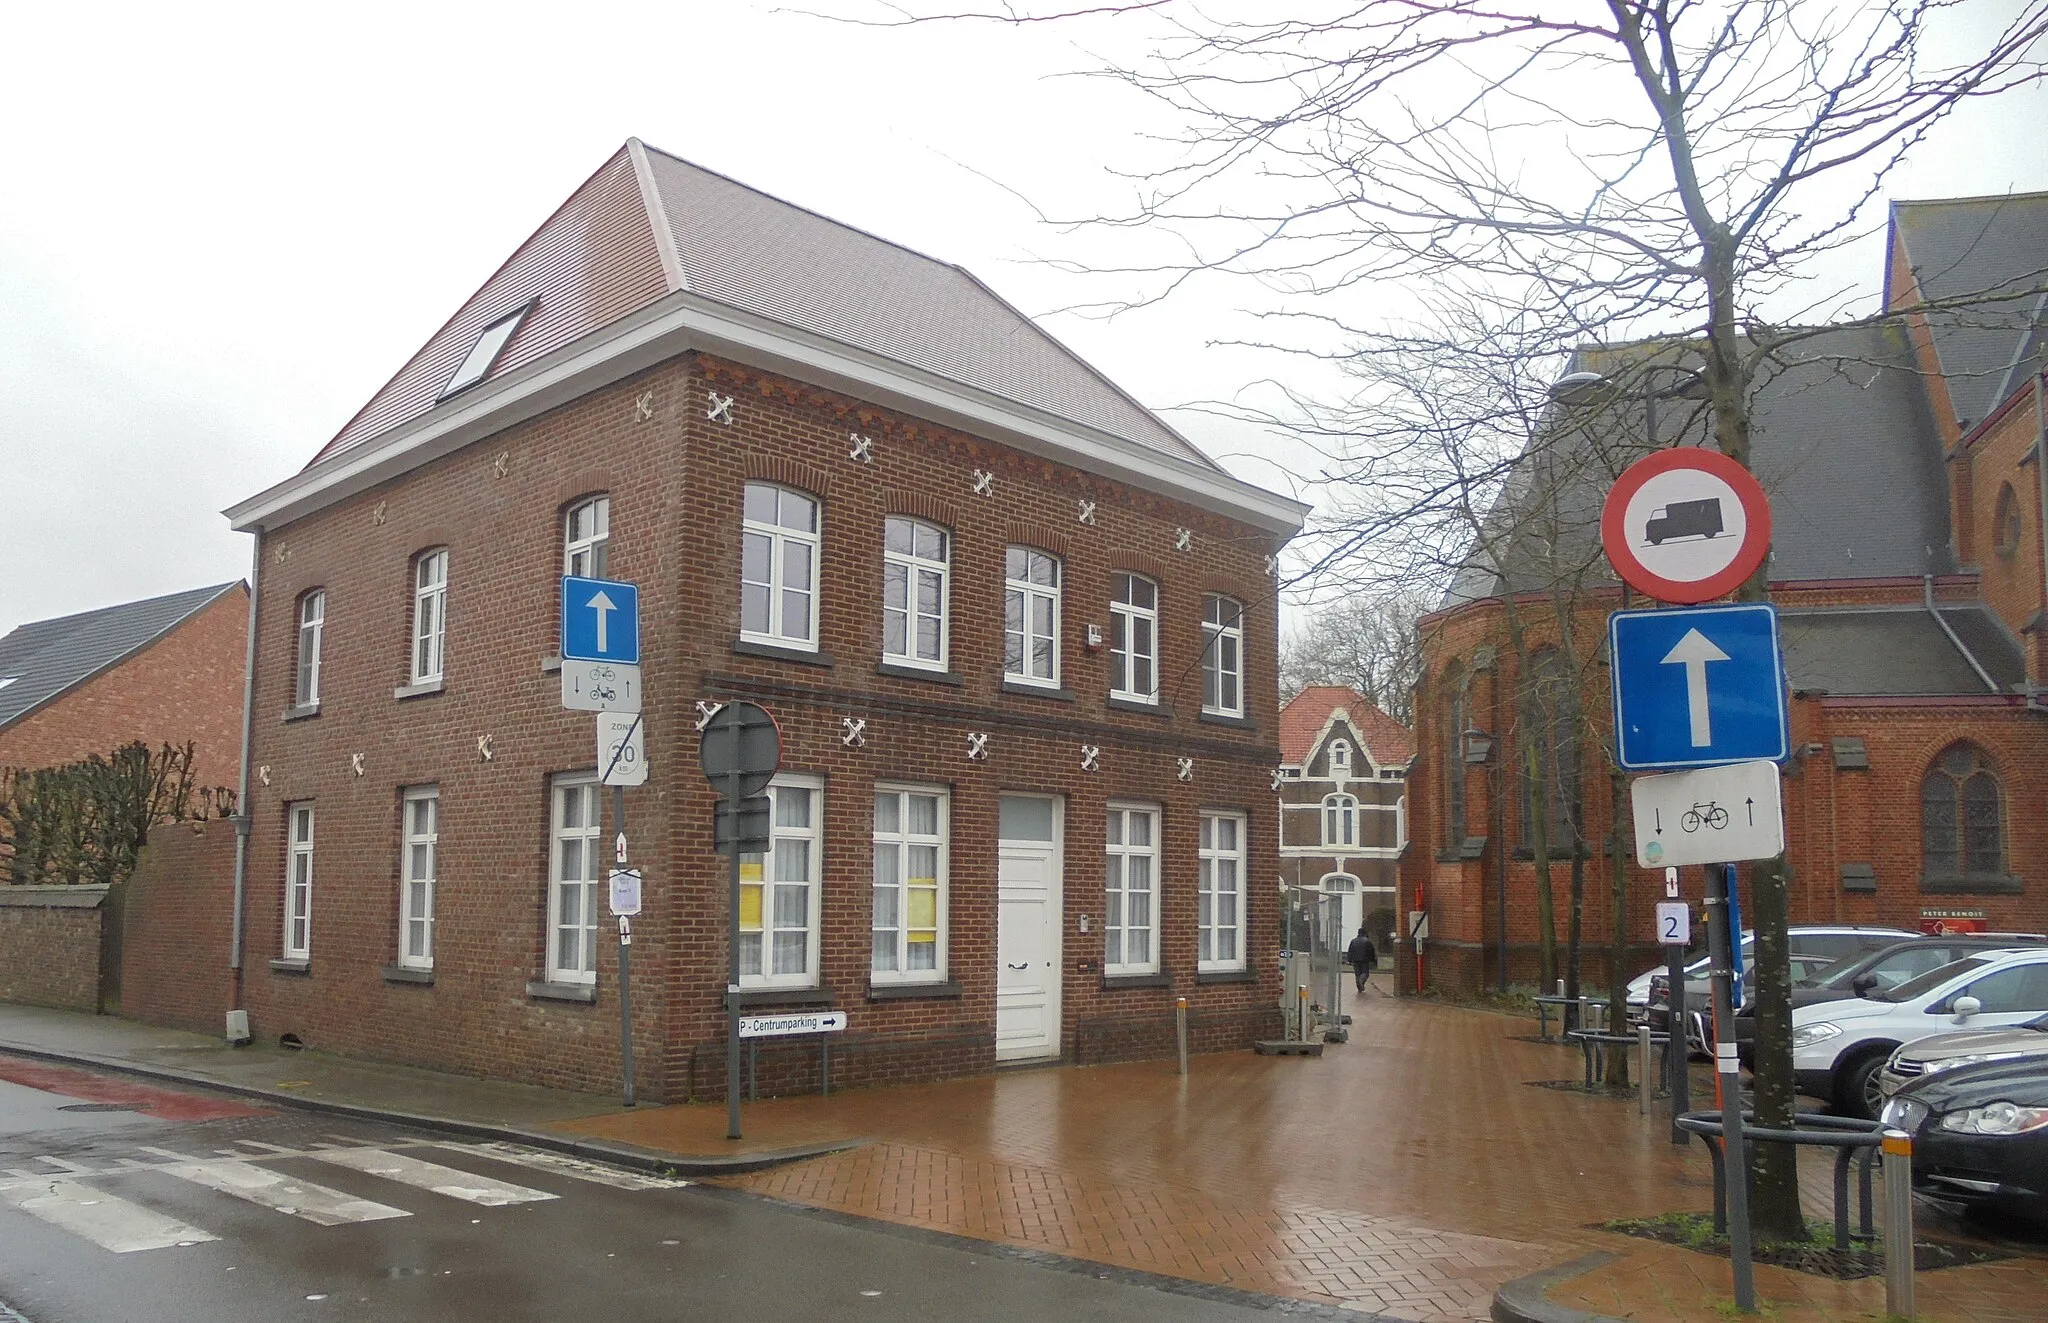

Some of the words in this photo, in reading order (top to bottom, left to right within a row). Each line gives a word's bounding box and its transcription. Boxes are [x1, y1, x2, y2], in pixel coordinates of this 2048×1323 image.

[611, 722, 635, 731] ZONE
[611, 745, 635, 763] 30
[1664, 916, 1679, 938] 2
[740, 1021, 746, 1032] P
[753, 1017, 817, 1032] Centrumparking
